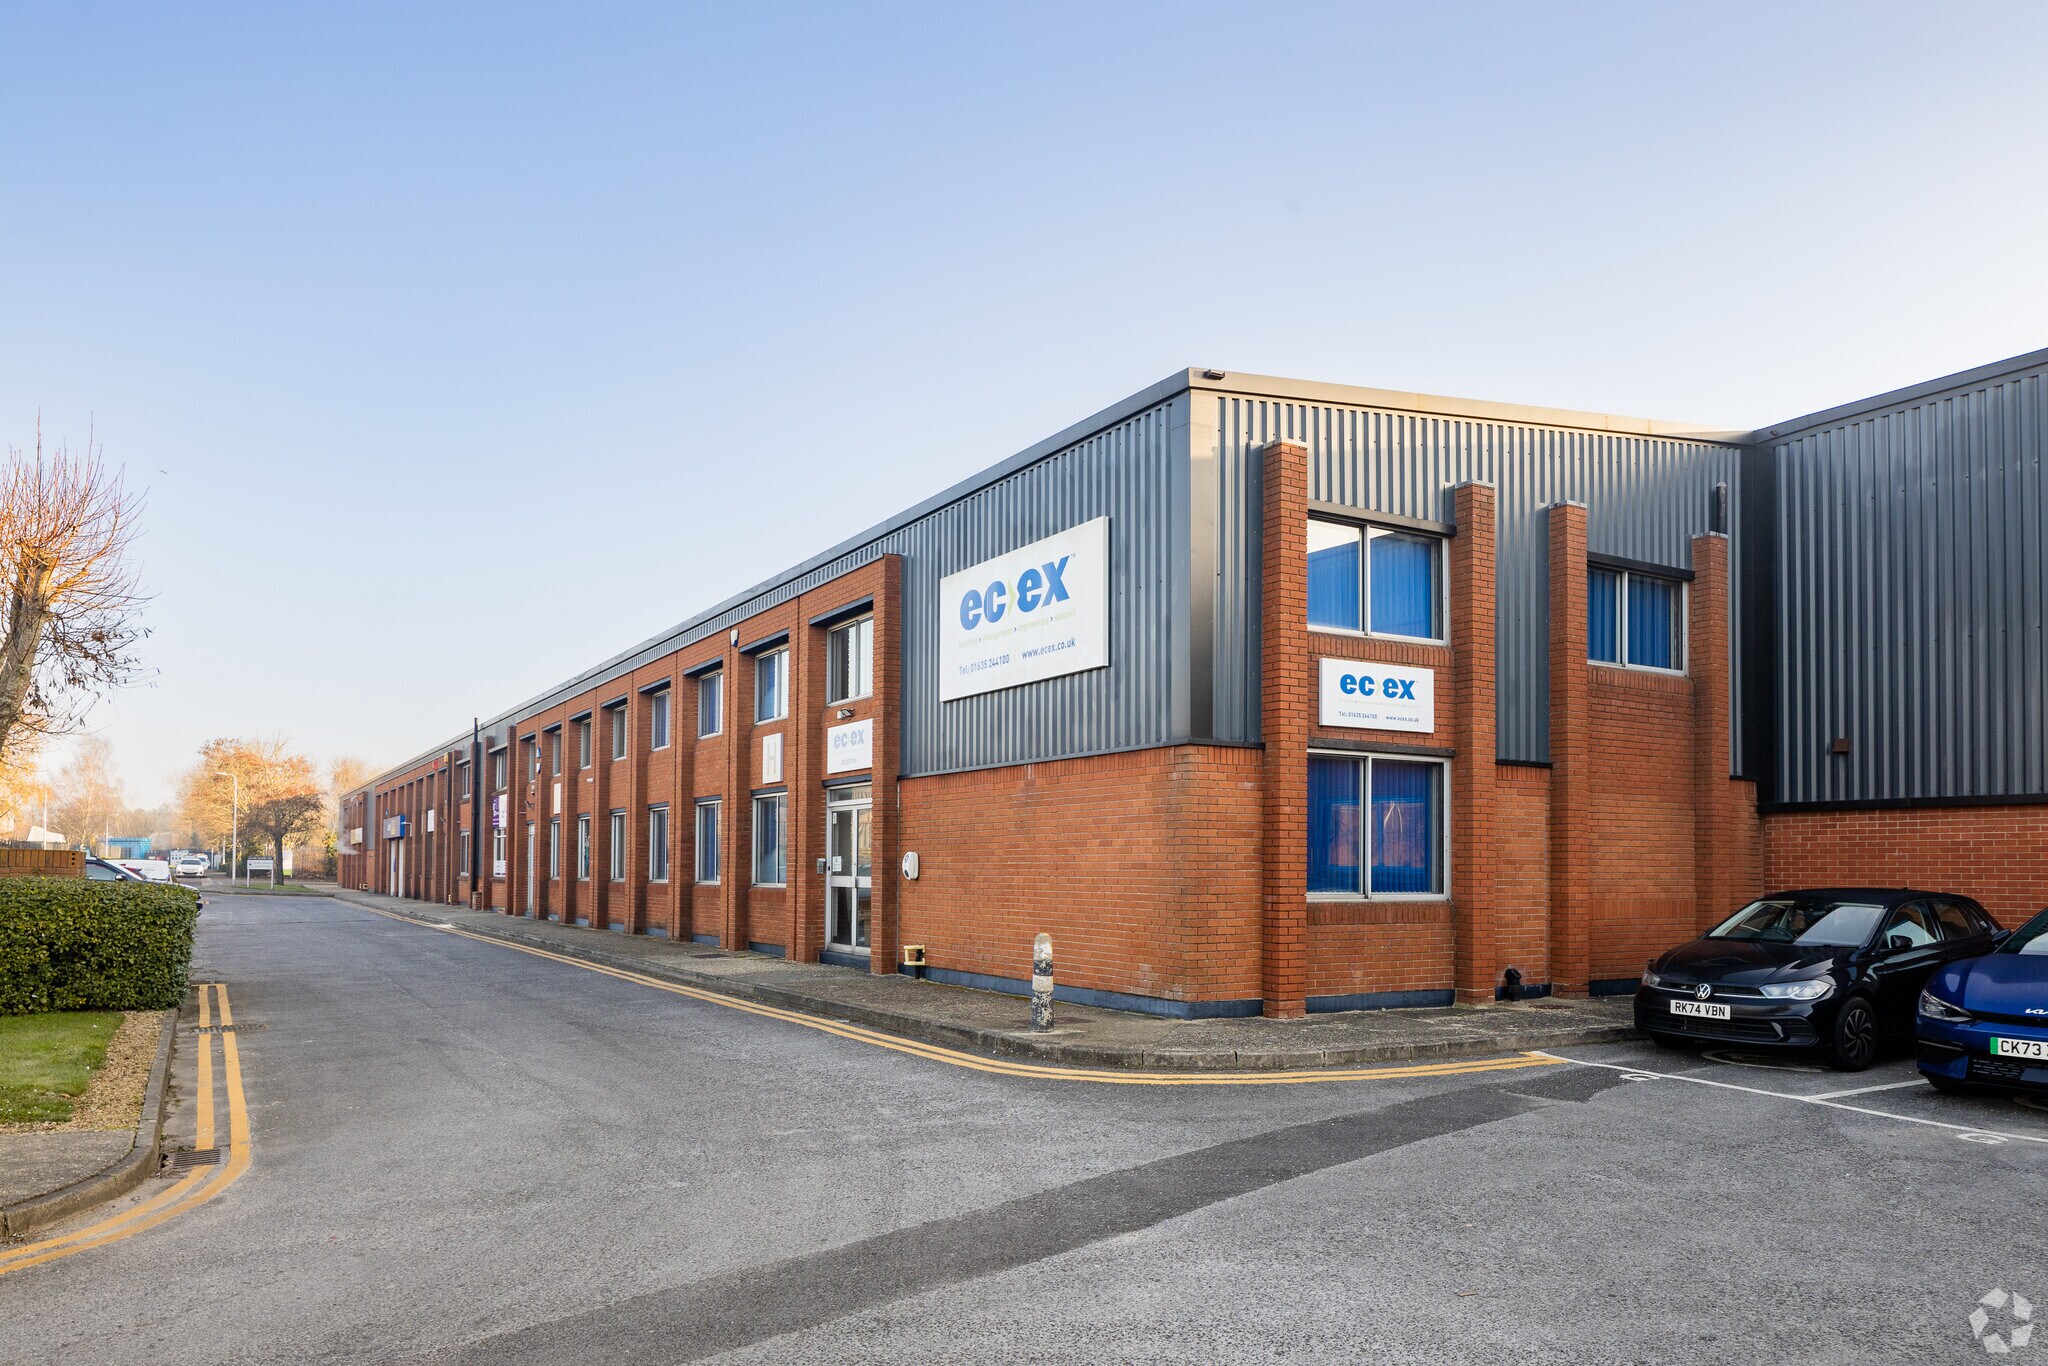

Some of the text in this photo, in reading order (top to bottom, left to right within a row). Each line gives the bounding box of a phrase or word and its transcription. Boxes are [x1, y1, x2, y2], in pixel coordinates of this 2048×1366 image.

[959, 637, 1076, 676] Tel: 01635 244100 www.ecex.co.uk
[1675, 1001, 1726, 1017] RK74 VBN
[2000, 1040, 2042, 1056] CK73
